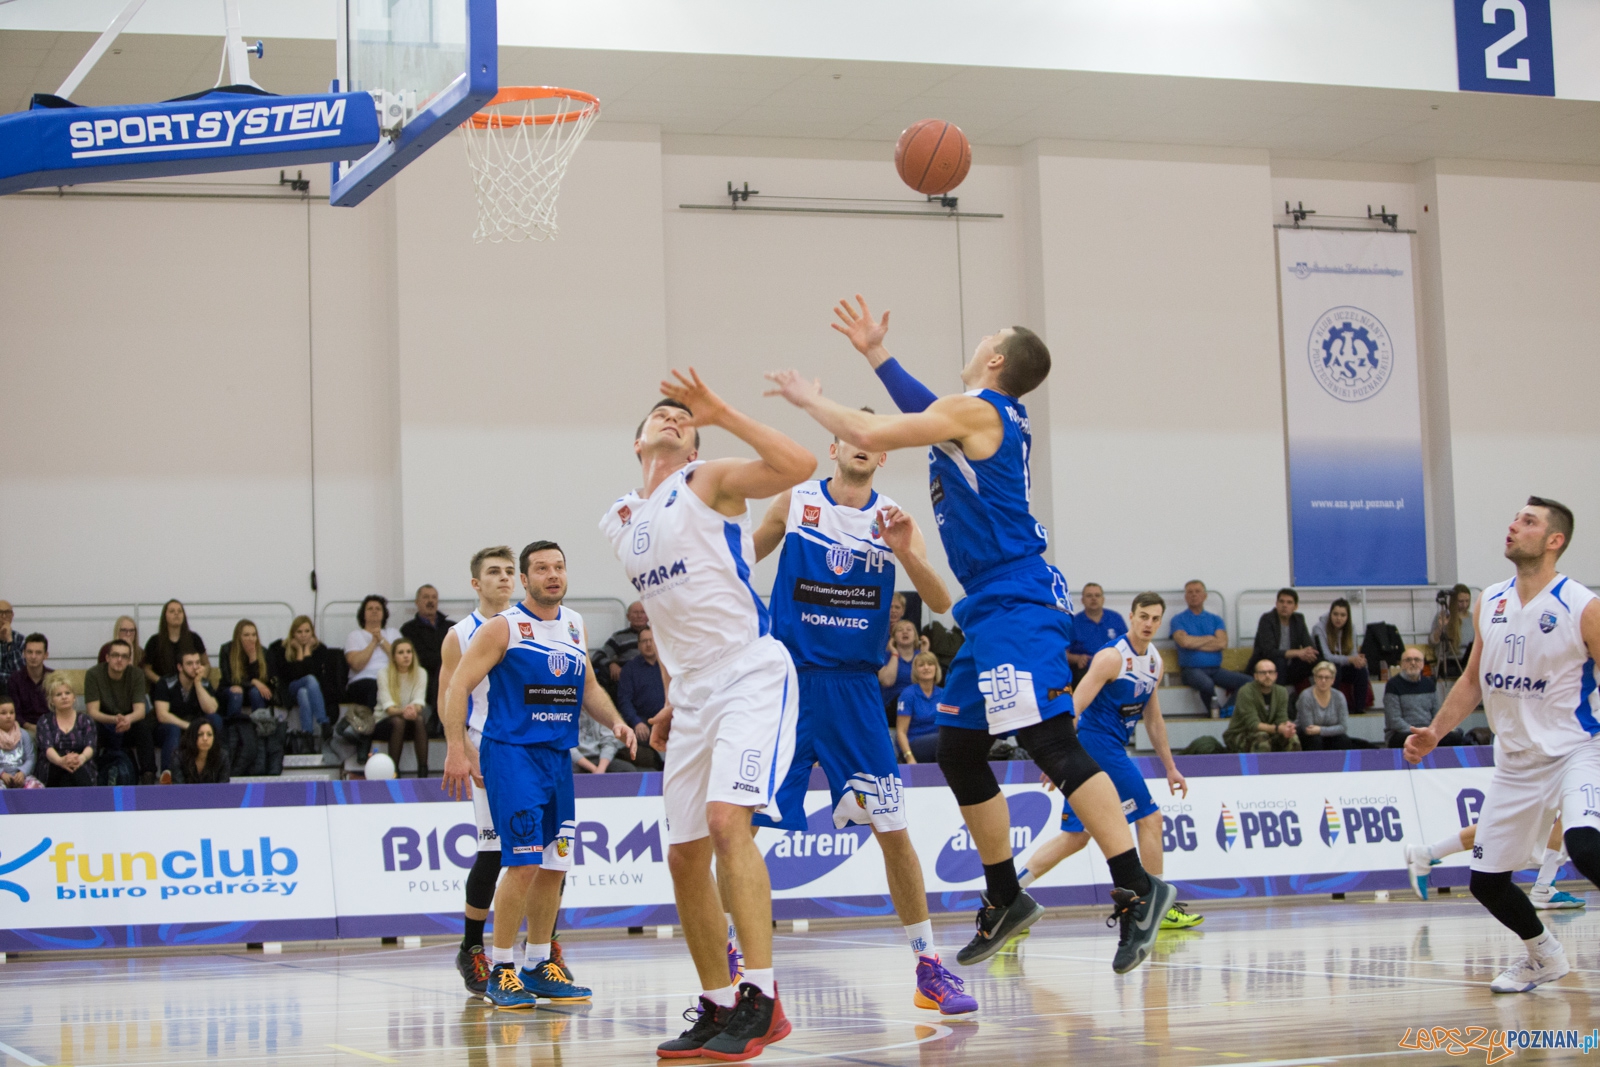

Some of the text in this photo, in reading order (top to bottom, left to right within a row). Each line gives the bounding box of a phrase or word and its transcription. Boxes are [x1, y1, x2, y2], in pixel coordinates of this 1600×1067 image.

[1482, 0, 1530, 81] 2
[69, 99, 347, 150] SPORTSYSTEM
[1316, 316, 1332, 337] KLUB
[633, 521, 650, 555] 6
[865, 548, 885, 574] 14
[801, 612, 869, 630] MORAWIEC
[1504, 633, 1526, 666] 11
[990, 663, 1020, 702] 13
[739, 749, 761, 782] 6
[875, 772, 901, 805] 14
[1236, 798, 1297, 811] fundacja
[1339, 794, 1398, 807] fundacja
[872, 806, 899, 815] COLO
[1341, 805, 1404, 844] PBG
[381, 819, 664, 872] BIORM
[775, 830, 859, 859] atrem
[1162, 814, 1199, 853] BG
[1239, 809, 1303, 849] PBG
[56, 878, 298, 900] biuro podróży
[588, 873, 644, 887] LEKÓW
